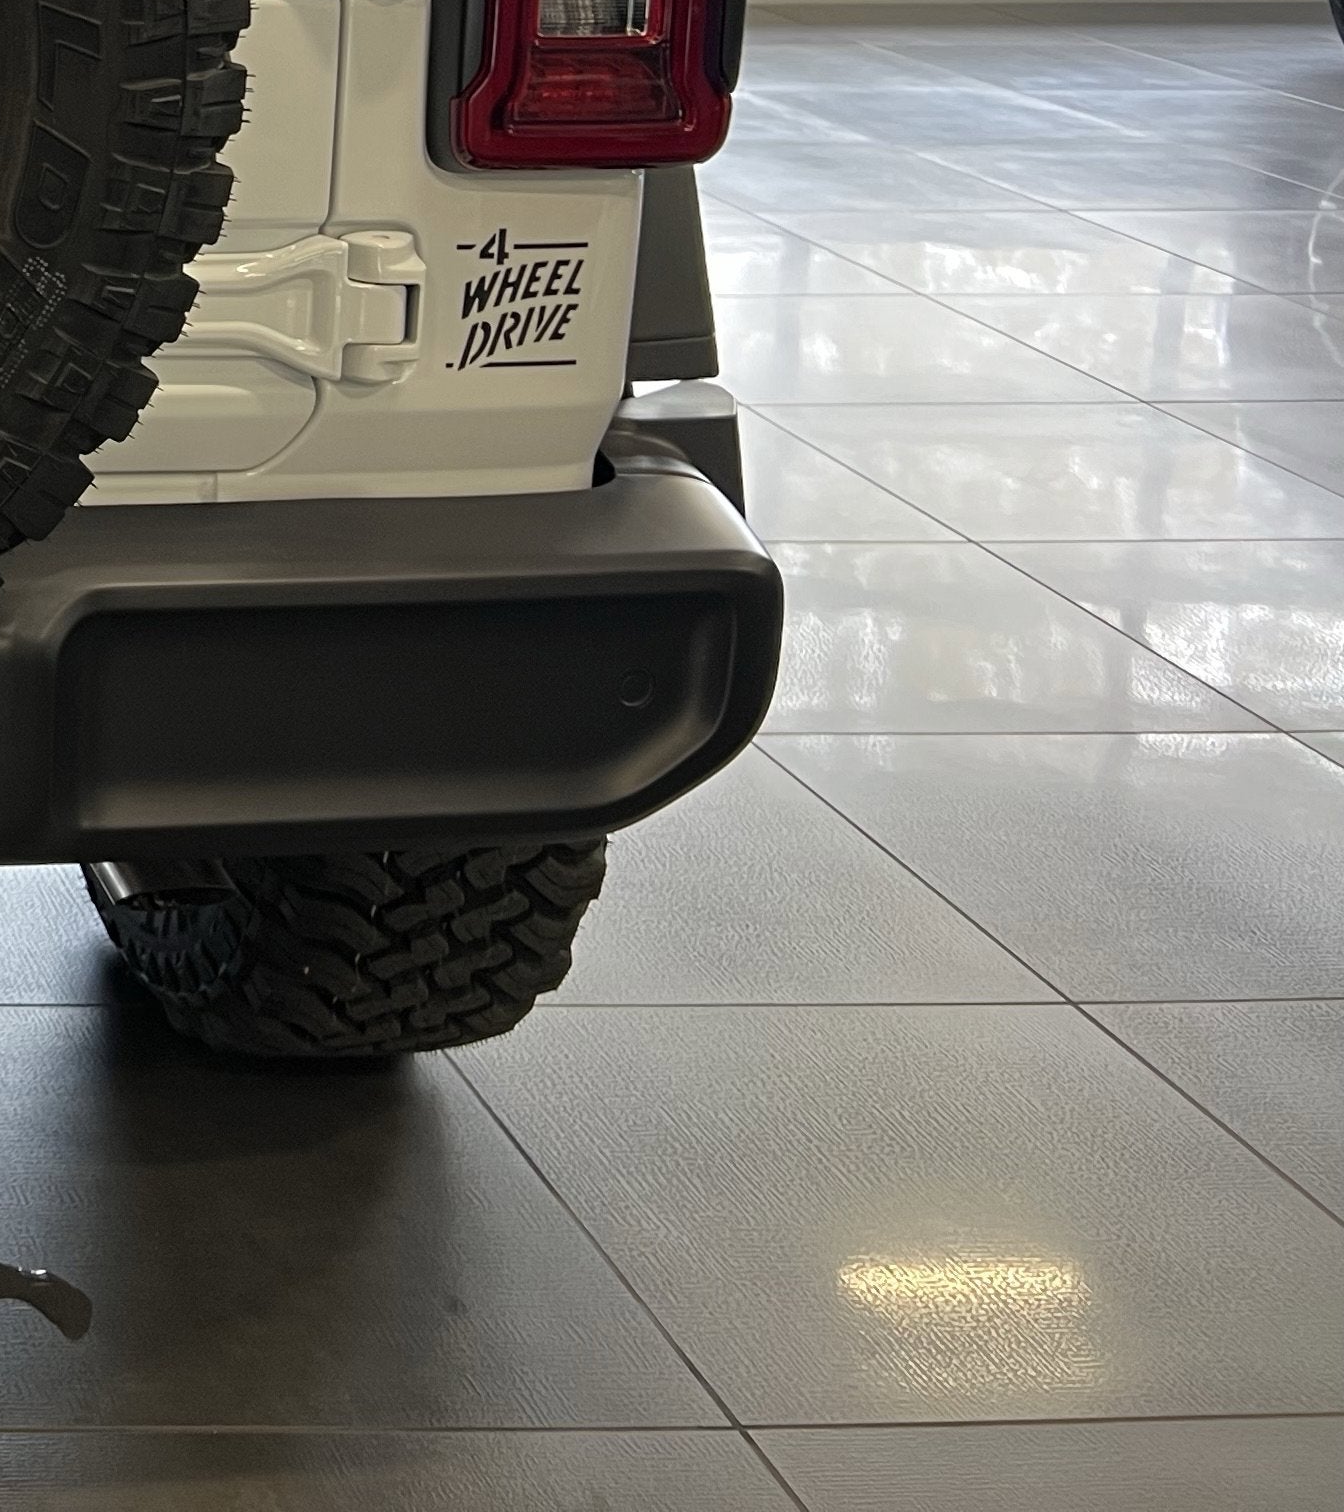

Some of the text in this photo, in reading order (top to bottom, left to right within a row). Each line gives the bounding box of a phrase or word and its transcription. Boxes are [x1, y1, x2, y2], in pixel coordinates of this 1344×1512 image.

[479, 228, 510, 265] 4
[461, 259, 585, 320] WHEEL
[458, 303, 579, 371] DRIVE
